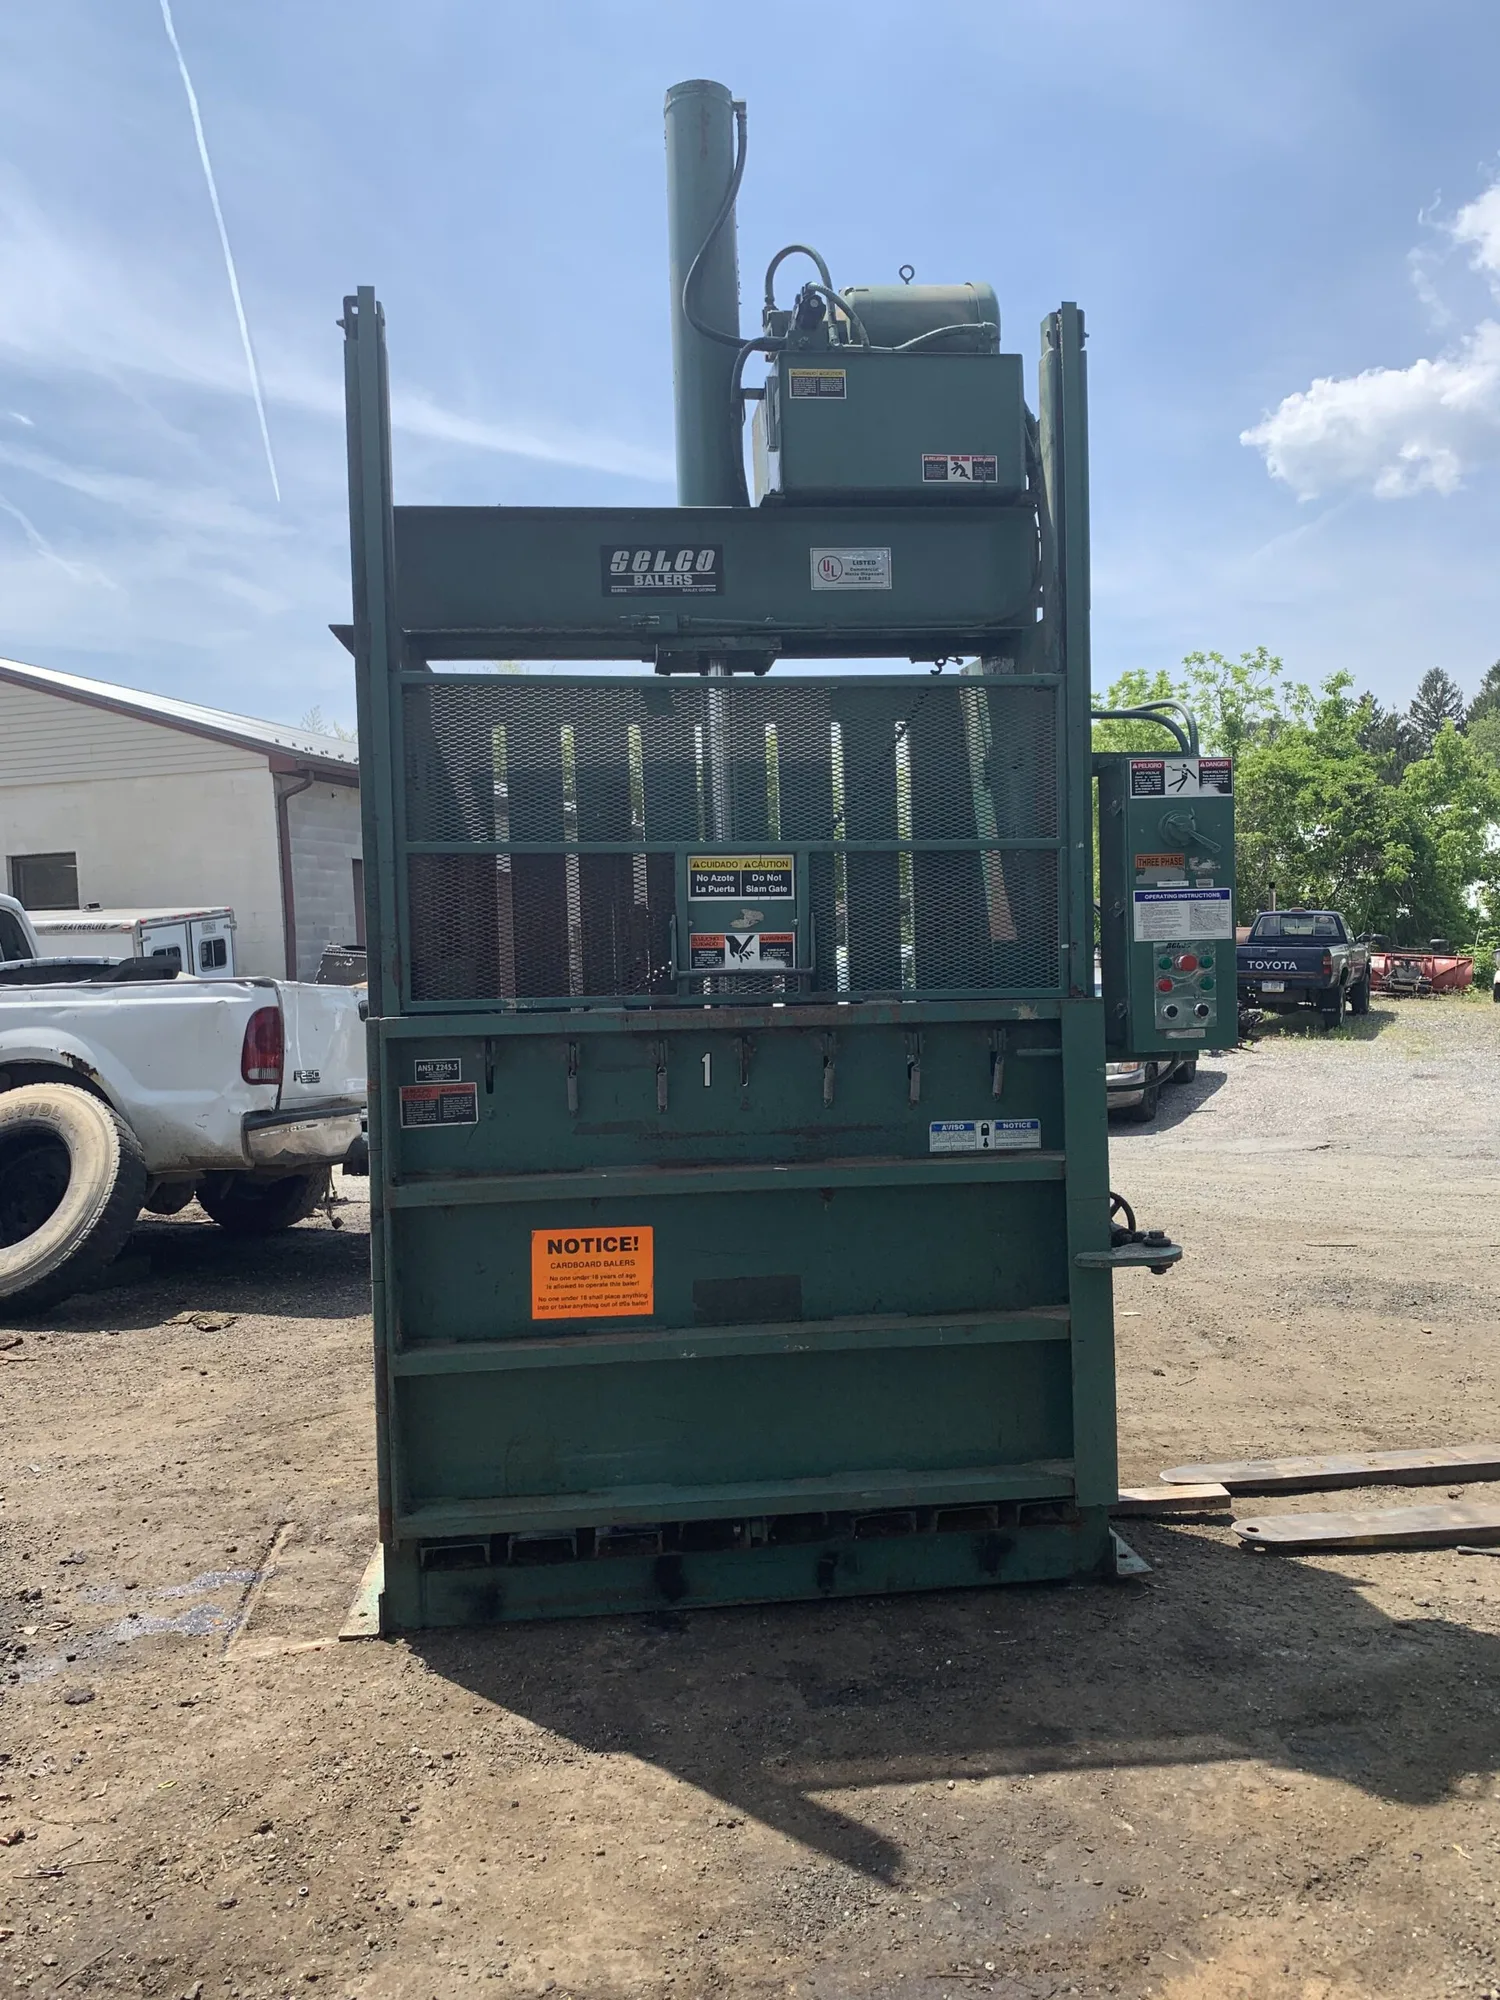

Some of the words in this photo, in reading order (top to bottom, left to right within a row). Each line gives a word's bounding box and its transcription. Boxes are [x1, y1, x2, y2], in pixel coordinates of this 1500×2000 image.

[610, 549, 715, 572] SELCO
[823, 559, 838, 577] UL
[634, 574, 693, 586] BALERS
[700, 860, 738, 868] CUIDADO
[751, 860, 789, 868] CAUTION
[1138, 858, 1159, 867] THREE
[1161, 857, 1183, 866] PHASE
[59, 922, 107, 931] FEATHERLITE
[1247, 960, 1298, 970] TOYOTA
[417, 1064, 434, 1072] ANSI
[436, 1063, 458, 1071] Z245.5
[701, 1053, 711, 1087] 1
[547, 1236, 639, 1255] NOTICE!
[550, 1260, 601, 1270] CARDBOARD
[603, 1259, 636, 1267] BALERS
